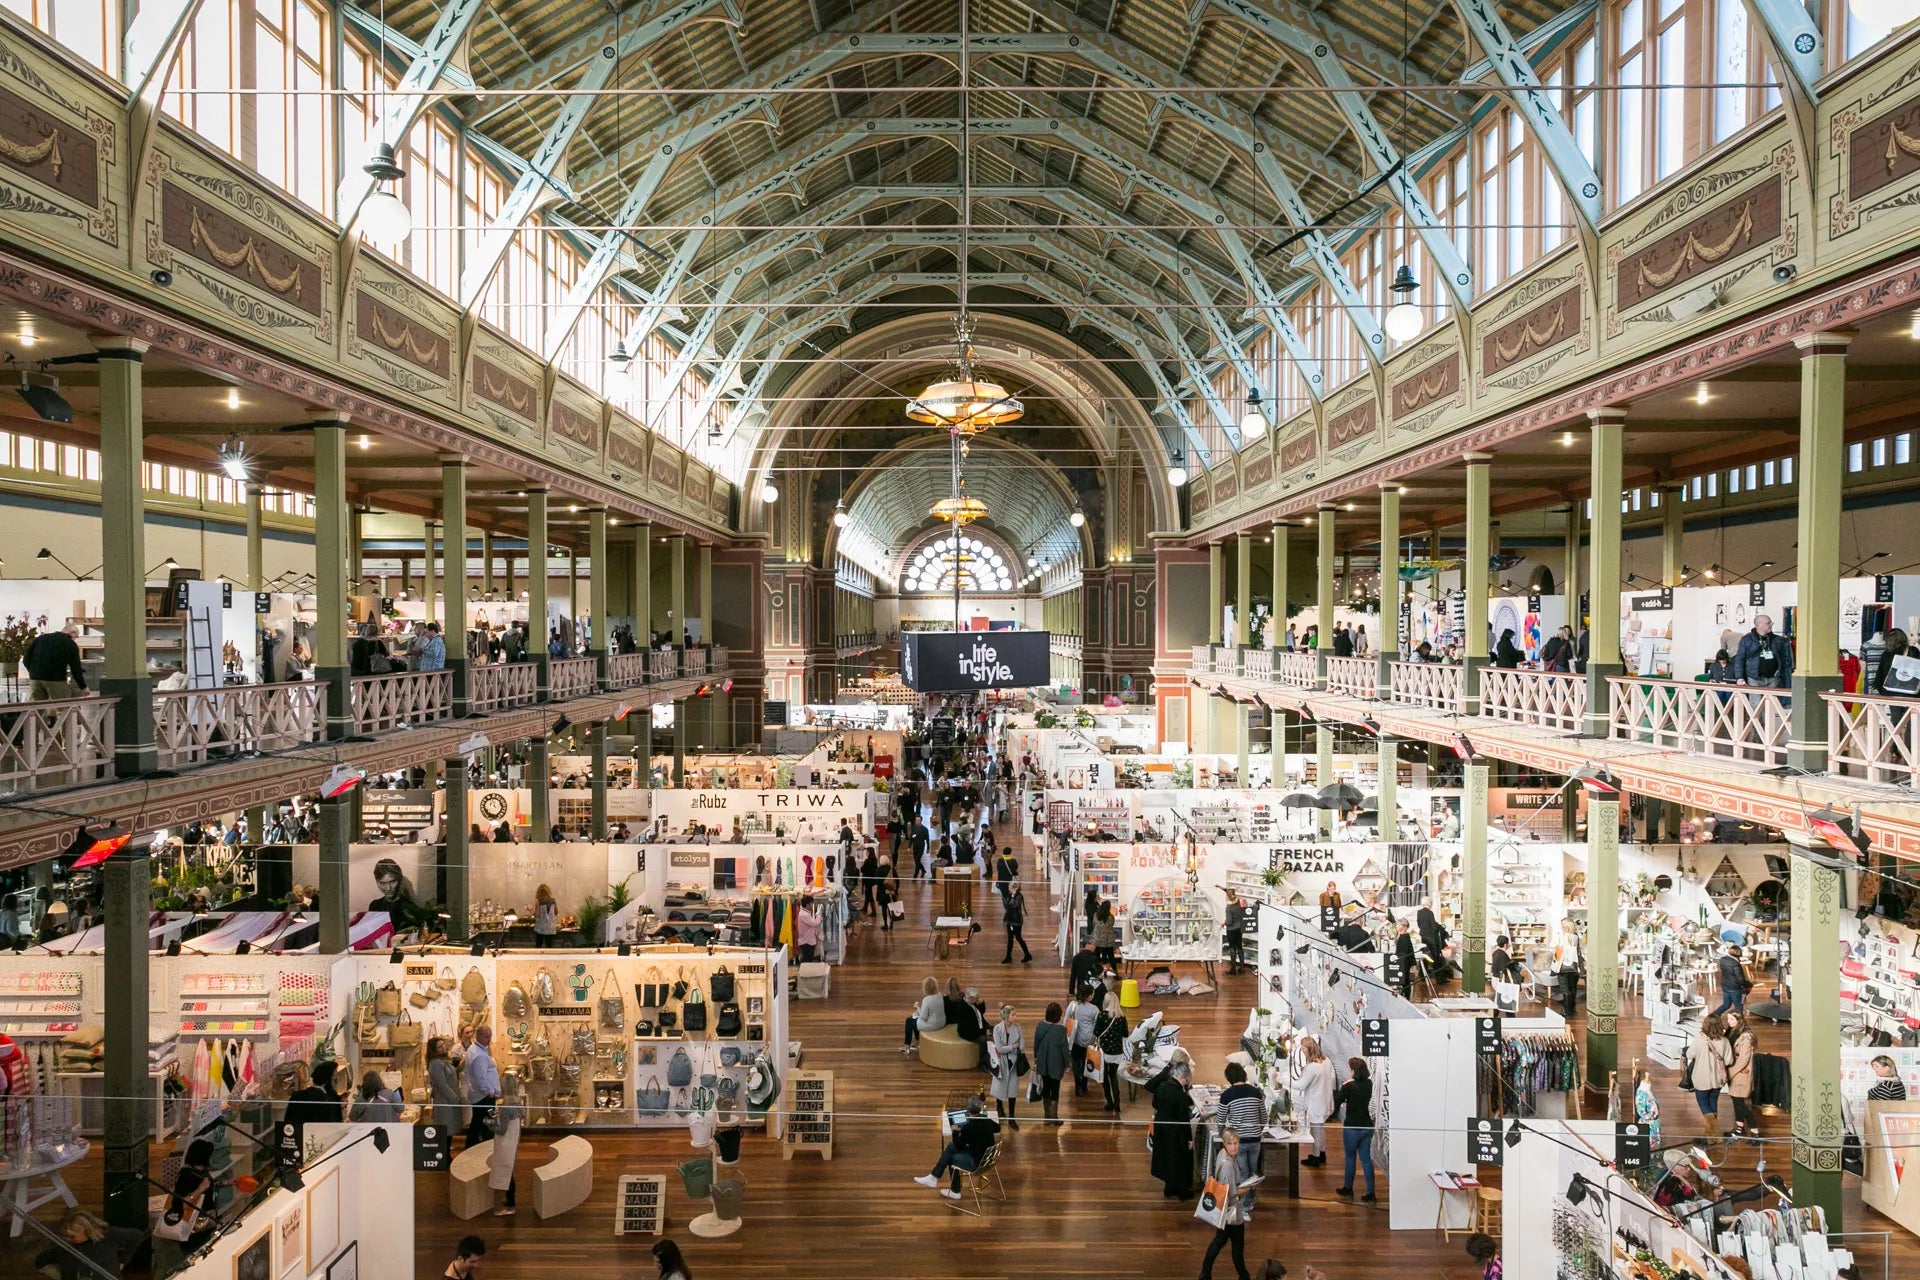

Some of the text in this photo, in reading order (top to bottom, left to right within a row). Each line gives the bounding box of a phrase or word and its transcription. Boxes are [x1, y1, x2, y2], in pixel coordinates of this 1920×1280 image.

[973, 635, 997, 663] life
[959, 653, 1014, 685] in style.
[699, 794, 727, 809] Rubz
[757, 794, 844, 807] TRIWA
[1515, 794, 1542, 804] WRITE
[1545, 795, 1555, 805] TO
[1276, 848, 1334, 860] FRENCH
[1283, 861, 1344, 873] BAZAAR
[407, 966, 433, 975] SAND
[738, 965, 765, 973] BLUE
[540, 1007, 591, 1015] UASHMAMA
[796, 1092, 824, 1100] MAMA
[796, 1102, 823, 1110] MADE
[789, 1123, 830, 1131] DESIGN
[802, 1133, 829, 1142] CARE
[1477, 1153, 1493, 1162] 1535
[627, 1183, 658, 1192] HAND
[625, 1195, 657, 1205] MADE
[625, 1208, 656, 1217] FROM
[625, 1220, 646, 1230] THE
